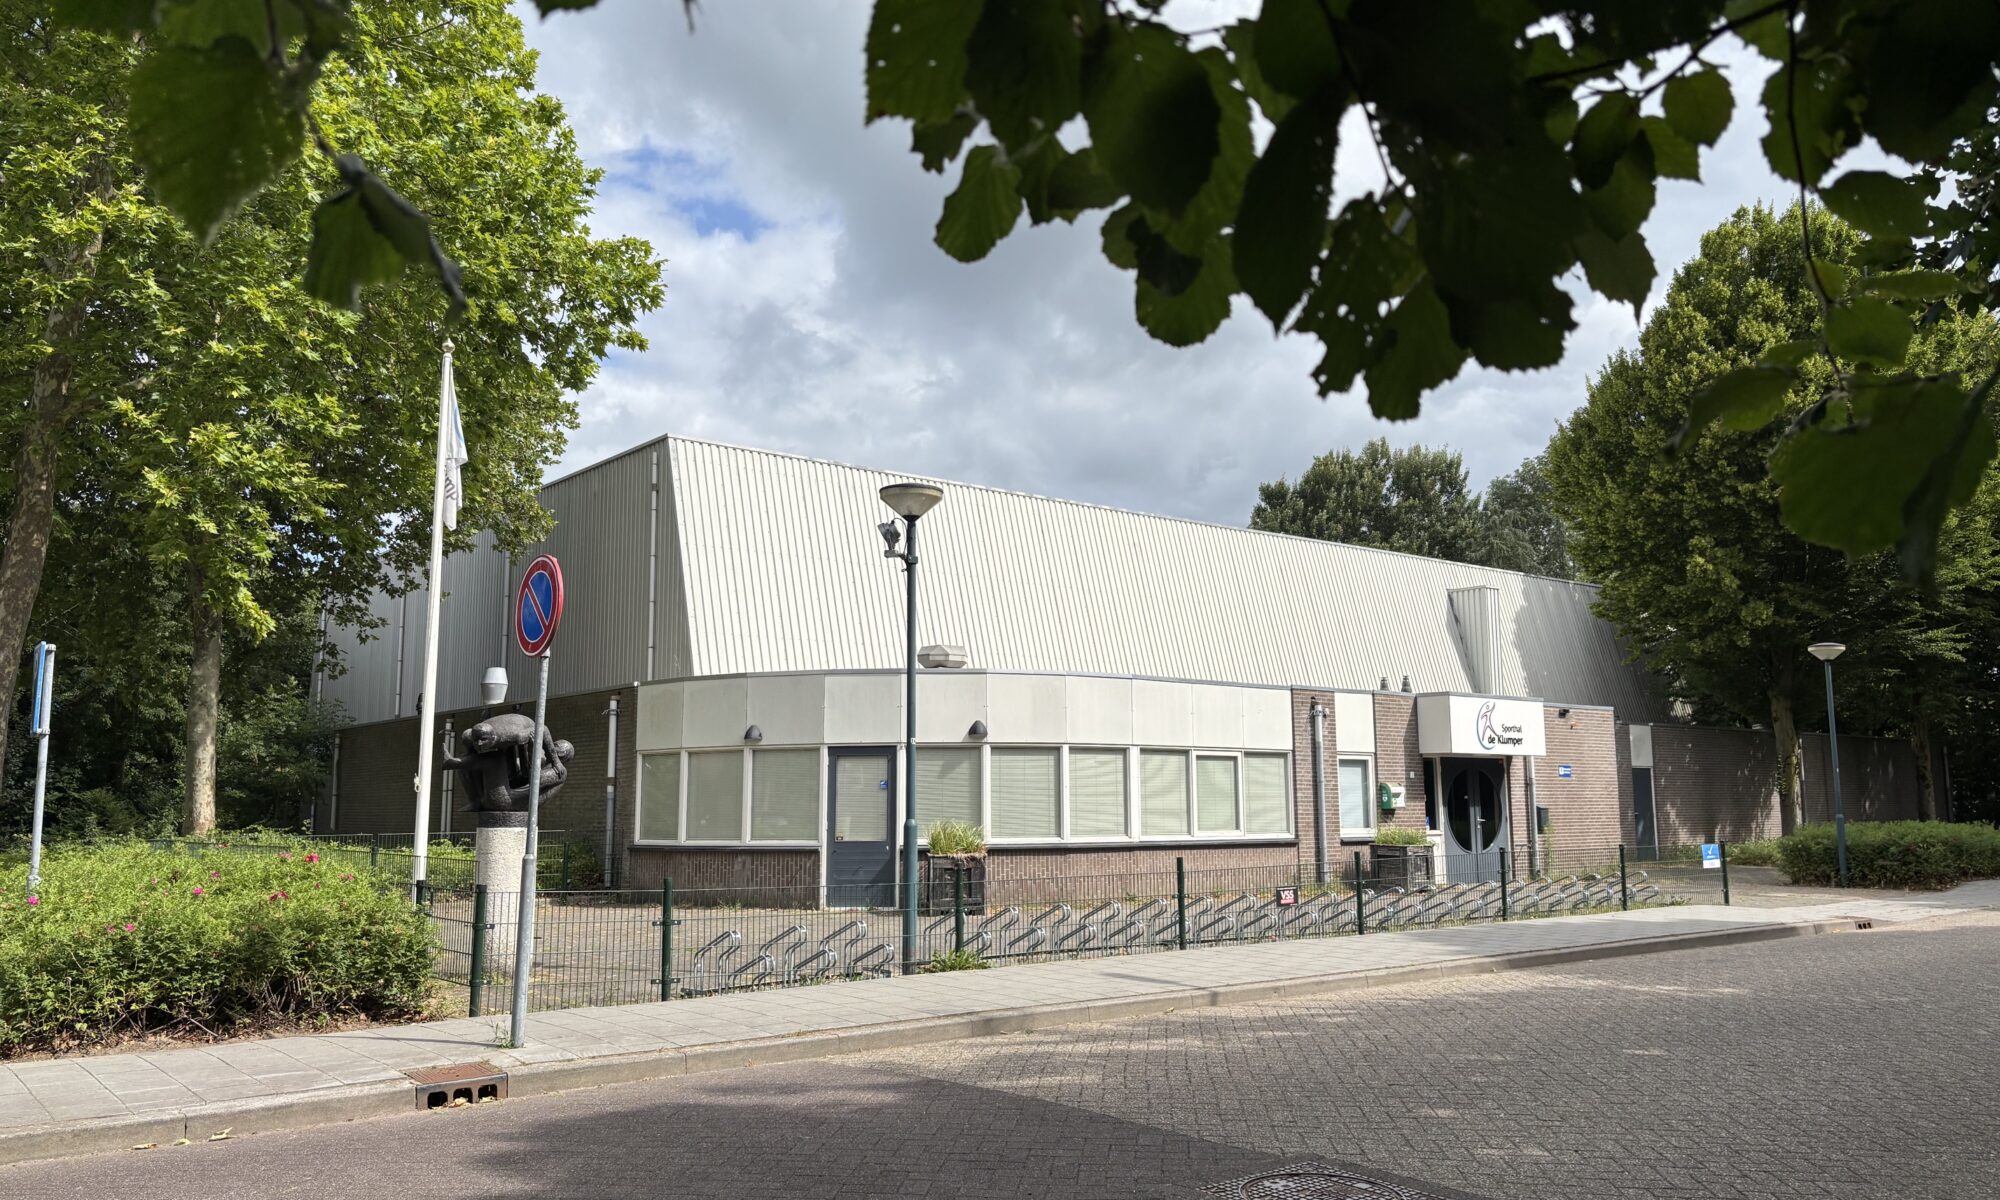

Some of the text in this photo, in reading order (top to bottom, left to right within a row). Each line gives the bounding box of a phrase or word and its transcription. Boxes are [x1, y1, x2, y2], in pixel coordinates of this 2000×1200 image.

[1501, 723, 1522, 734] Sporthal
[1487, 734, 1524, 748] de Klumper
[1280, 890, 1295, 900] VSS
